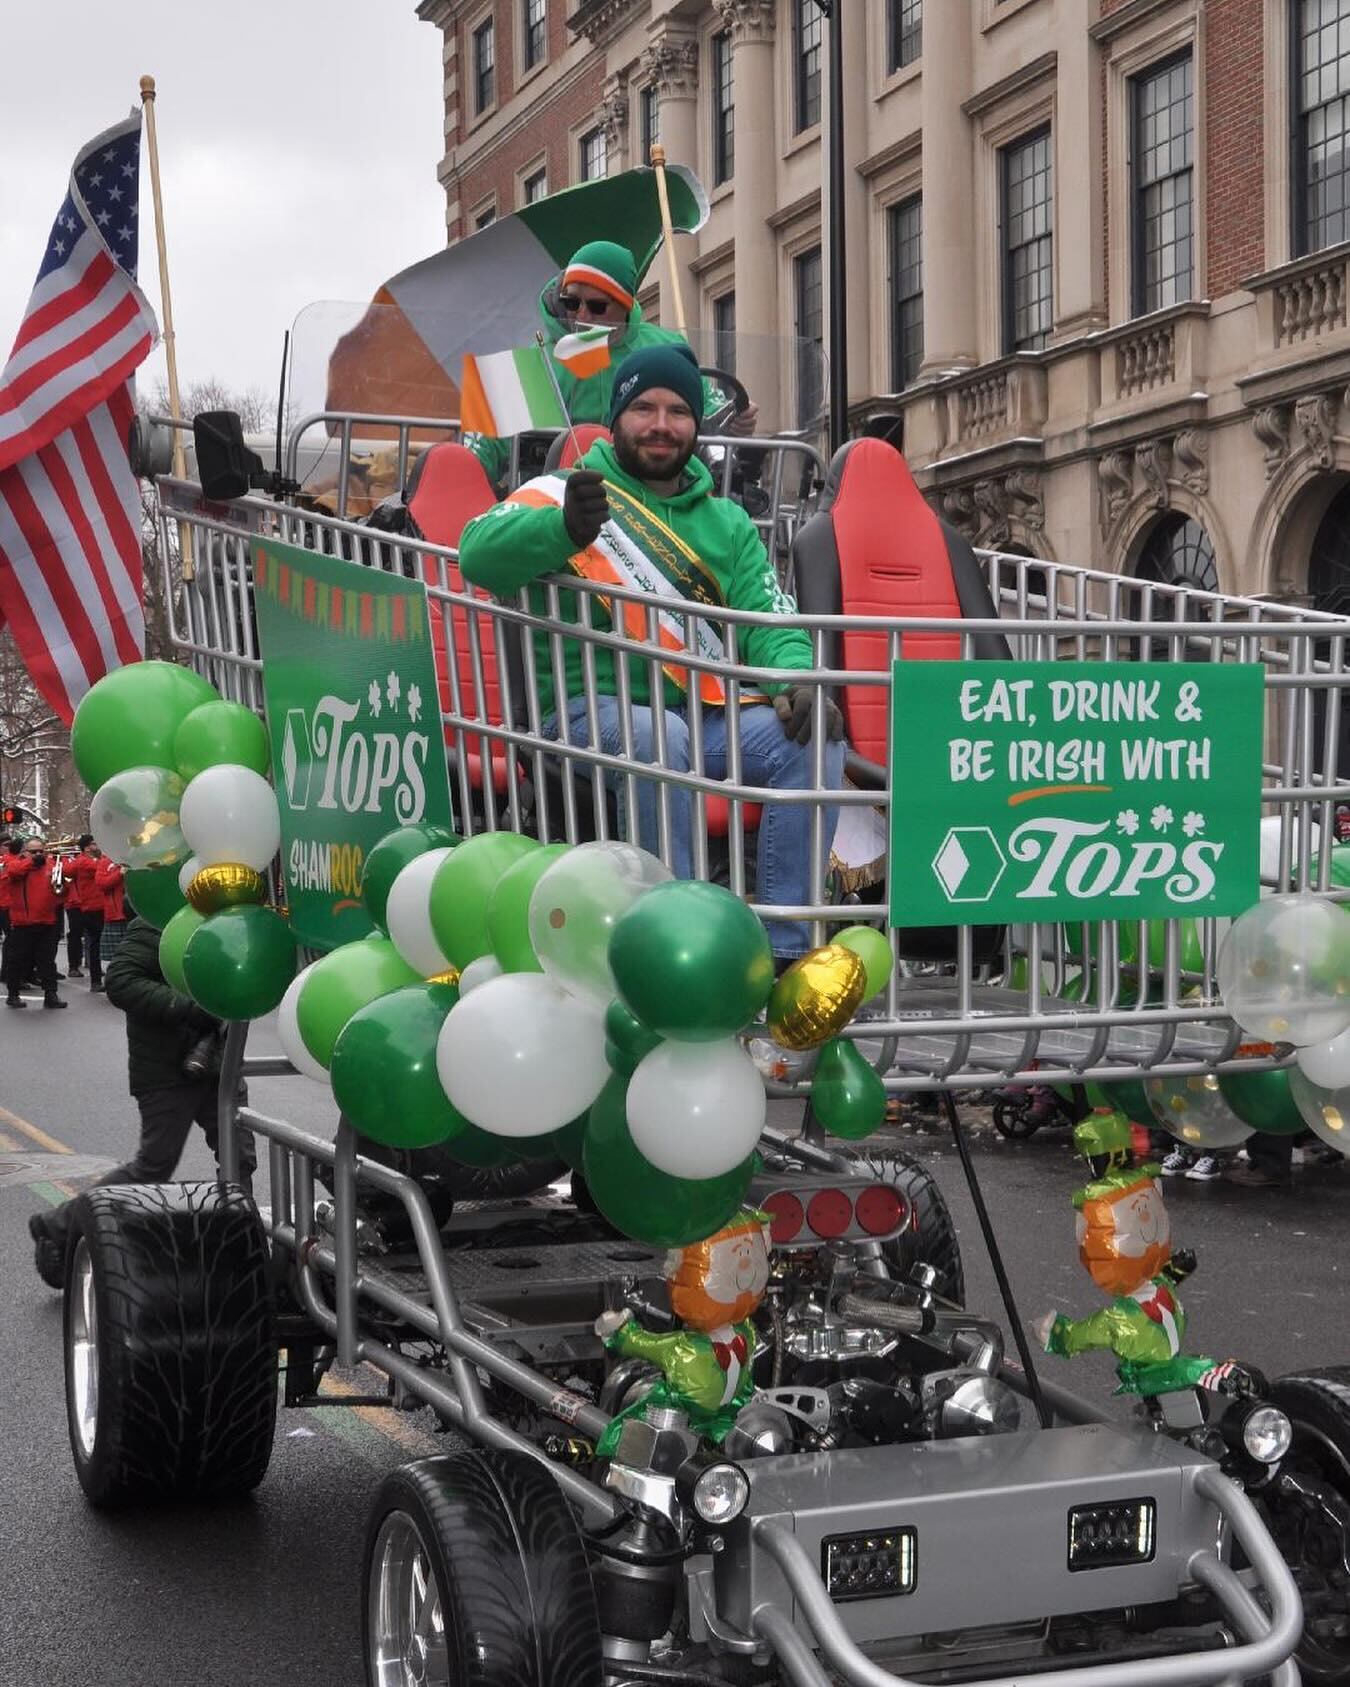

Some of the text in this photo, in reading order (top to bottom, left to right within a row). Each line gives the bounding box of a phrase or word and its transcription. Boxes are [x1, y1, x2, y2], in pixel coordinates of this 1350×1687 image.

[600, 529, 635, 571] NESS
[959, 679, 1202, 728] EAT, DRINK &
[948, 737, 1211, 784] BE IRISH WITH
[290, 838, 363, 897] SHAMROC
